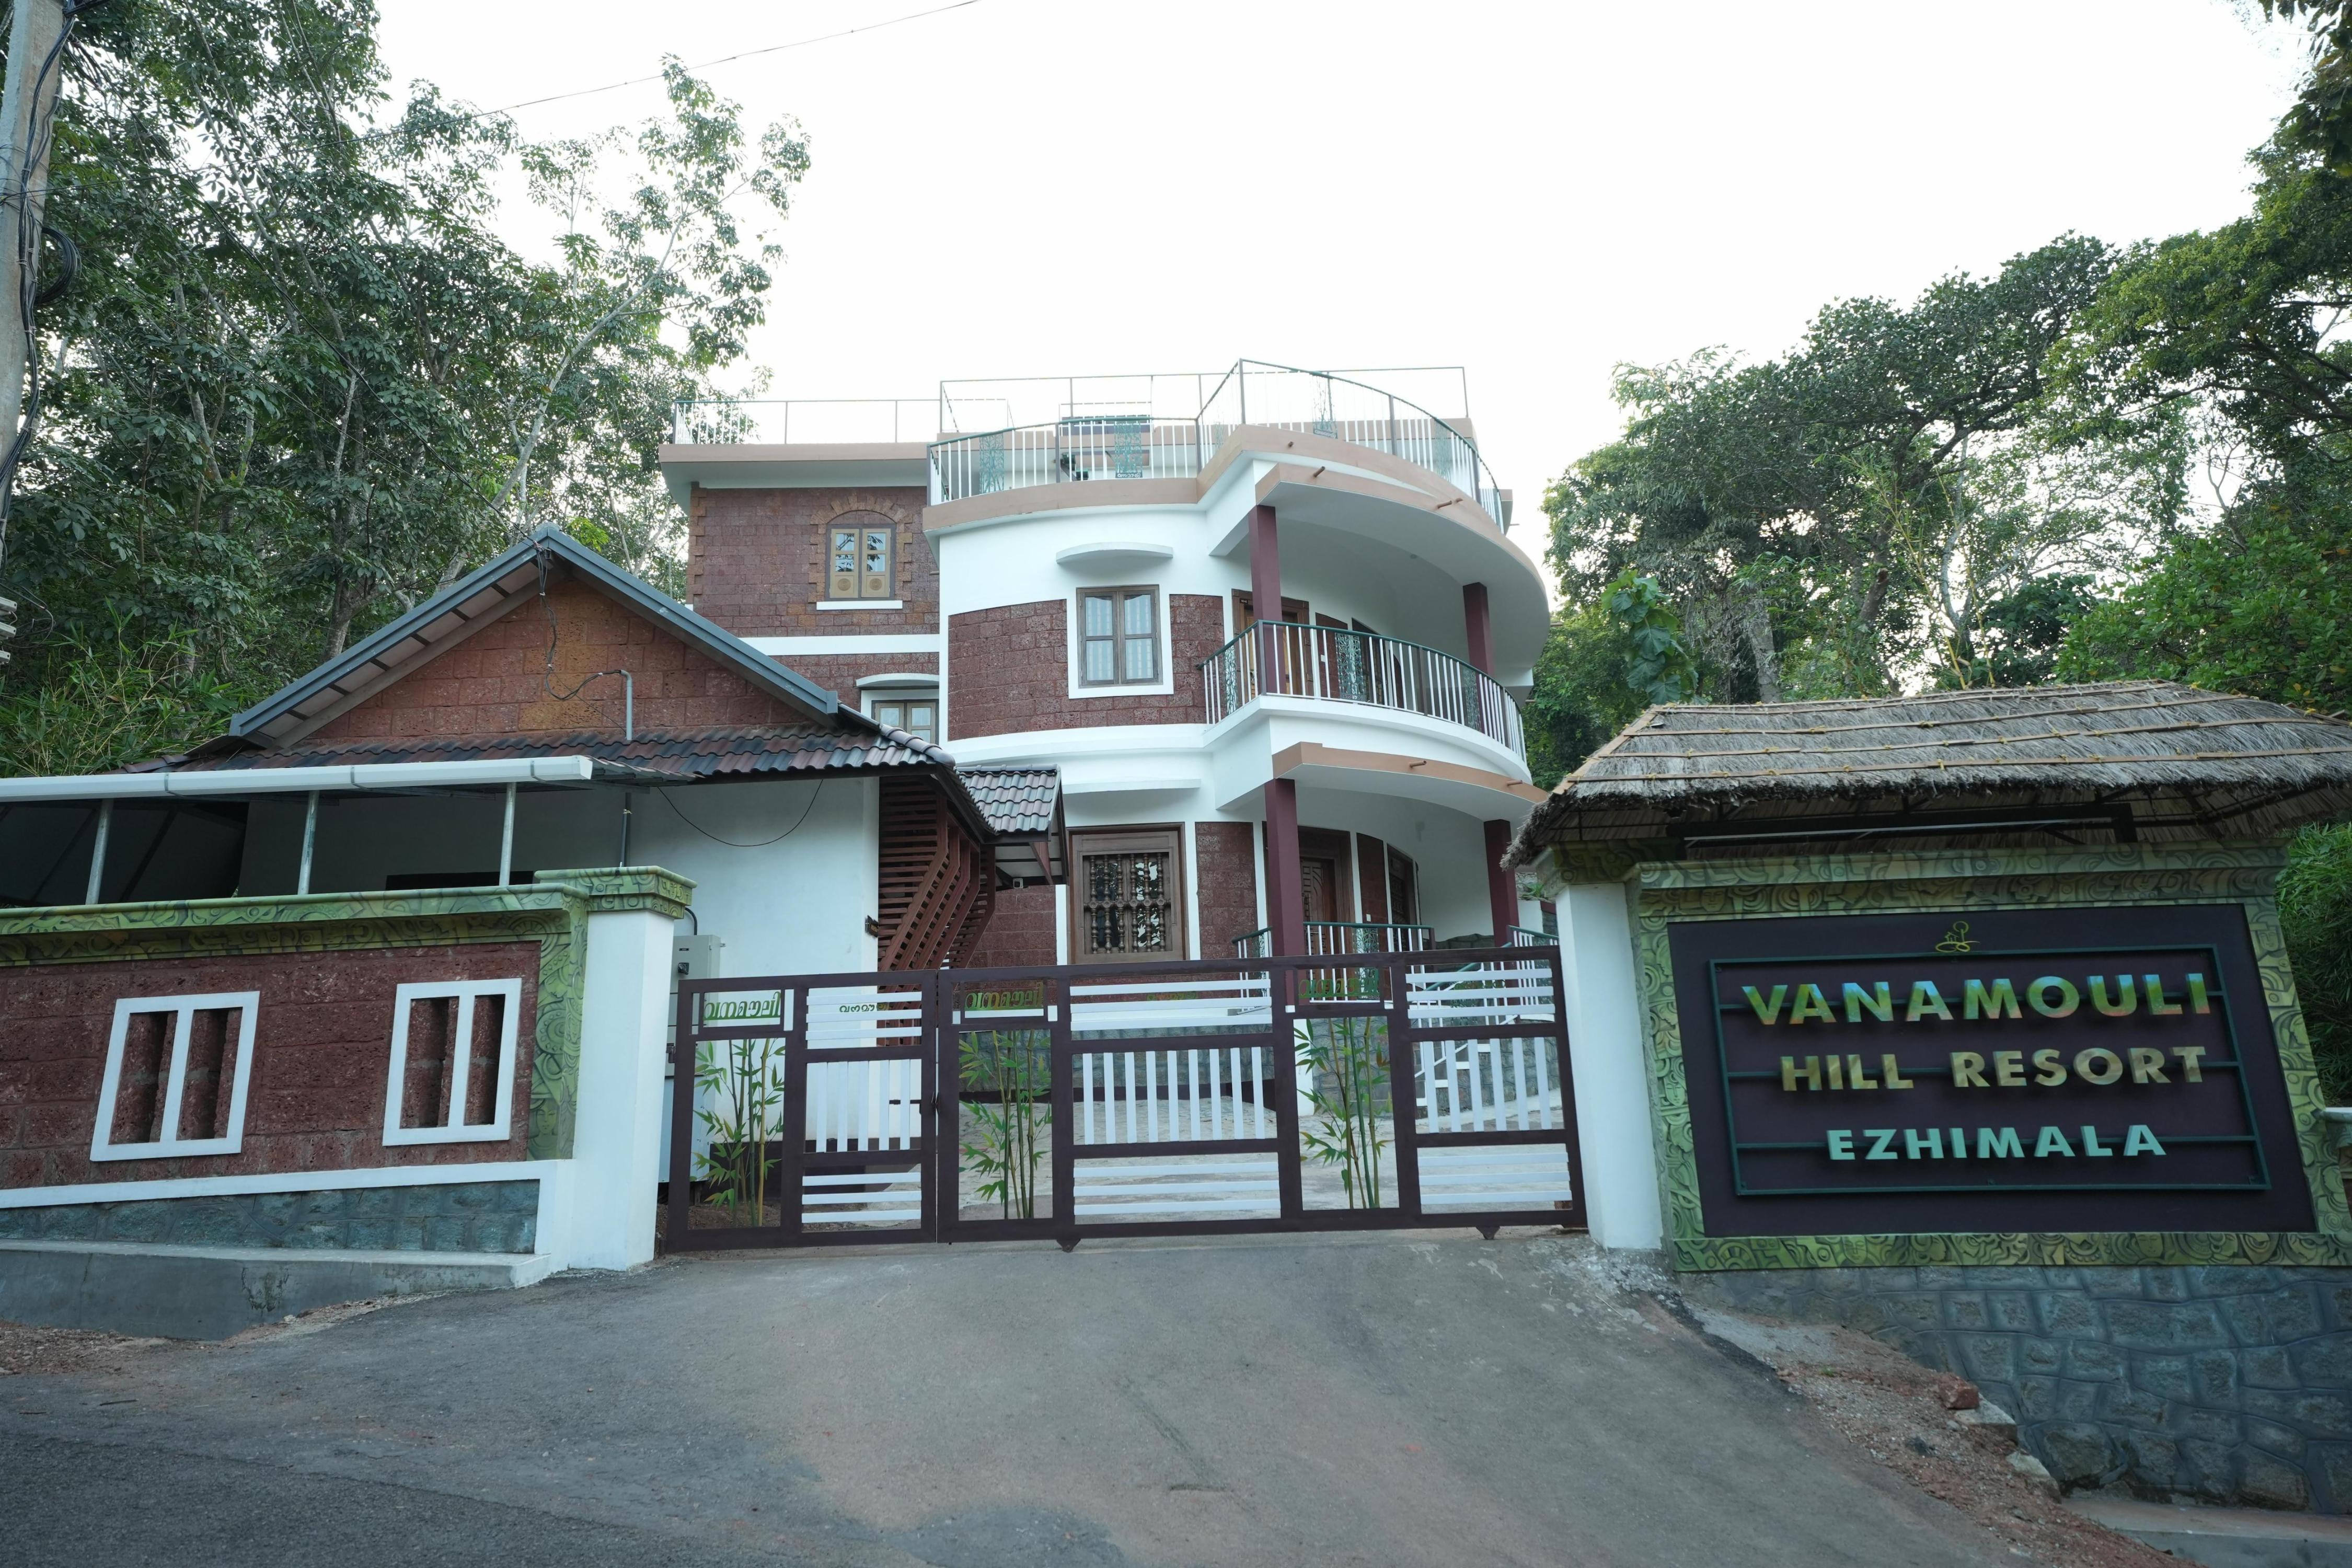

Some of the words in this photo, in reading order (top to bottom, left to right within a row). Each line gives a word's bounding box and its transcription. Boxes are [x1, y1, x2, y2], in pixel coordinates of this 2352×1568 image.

[704, 991, 781, 1020] വനമൗലി
[1742, 973, 2210, 1025] VANAMOULI
[1780, 1054, 1914, 1091] HILL
[1950, 1046, 2206, 1088] RESORT
[1827, 1125, 2166, 1160] EZHIMALA
